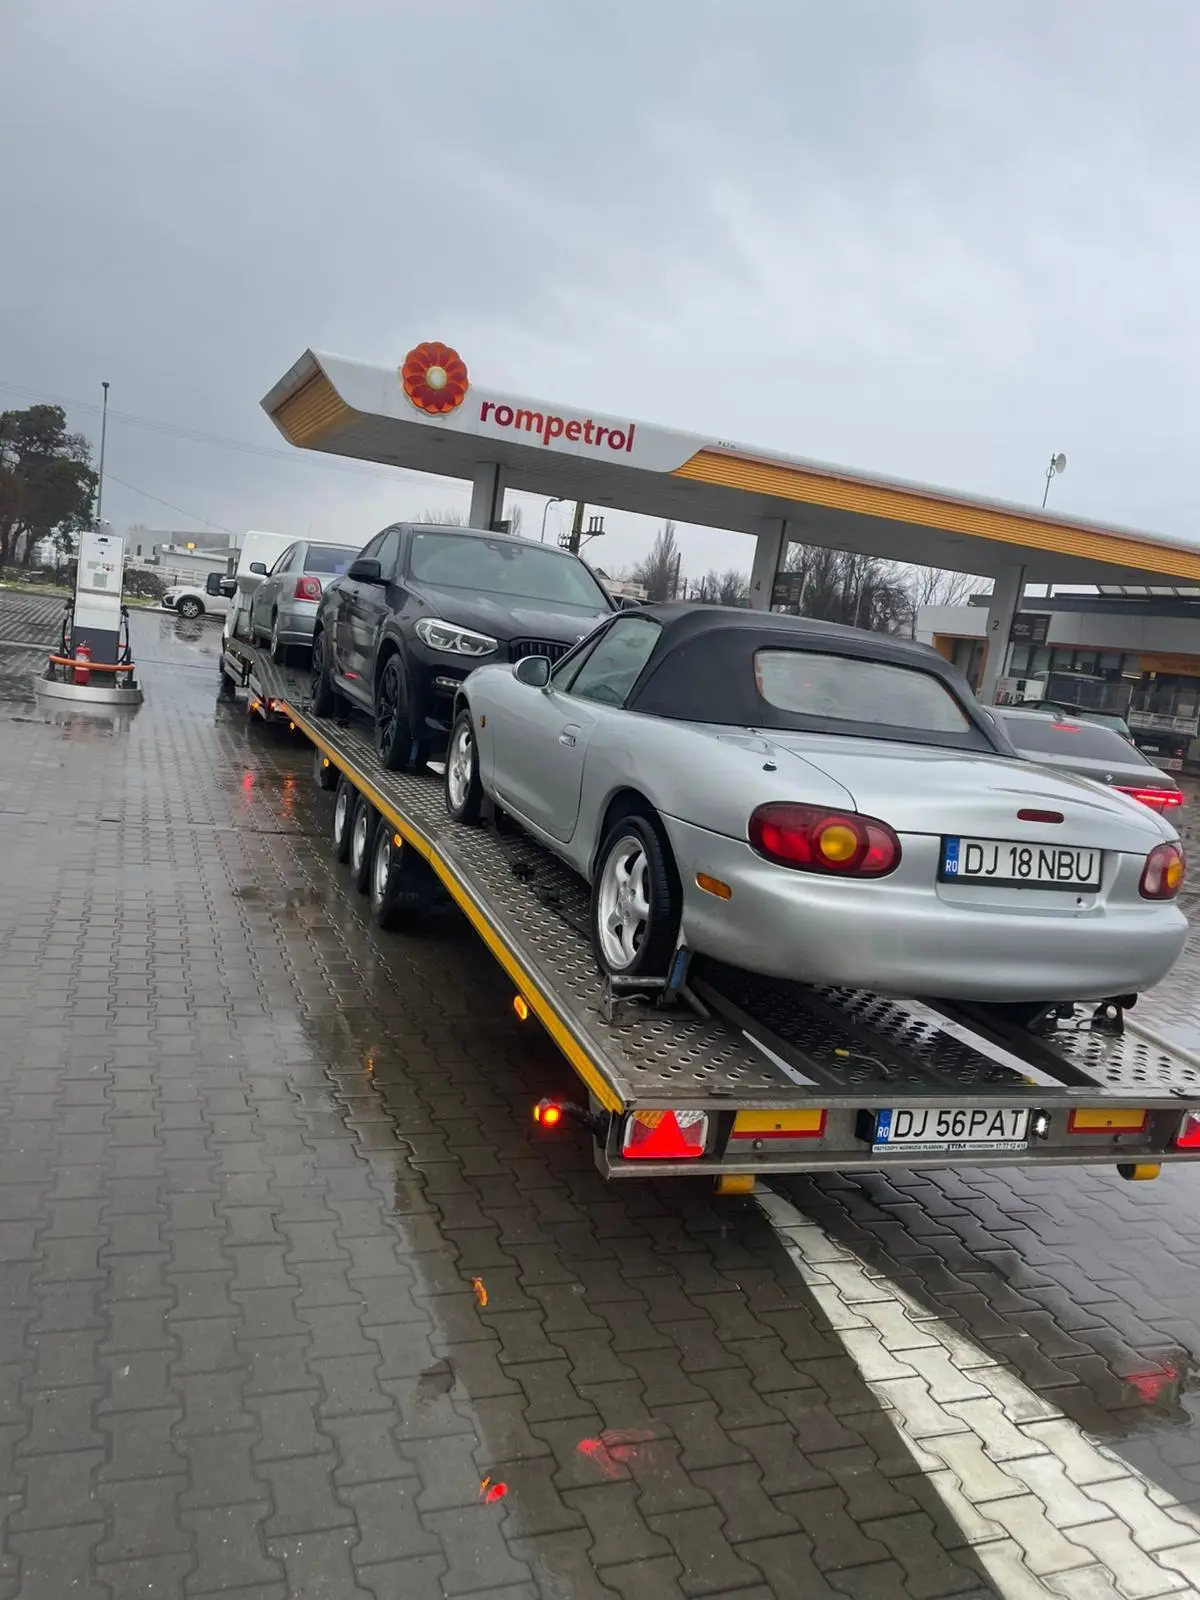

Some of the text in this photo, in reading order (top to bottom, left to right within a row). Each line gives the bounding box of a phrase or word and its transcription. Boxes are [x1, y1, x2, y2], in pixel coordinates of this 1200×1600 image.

[480, 400, 636, 452] rompetrol
[991, 620, 1000, 631] 2
[945, 859, 958, 873] RO
[965, 844, 999, 875] DJ
[877, 1126, 889, 1138] RO
[894, 1110, 928, 1138] DJ
